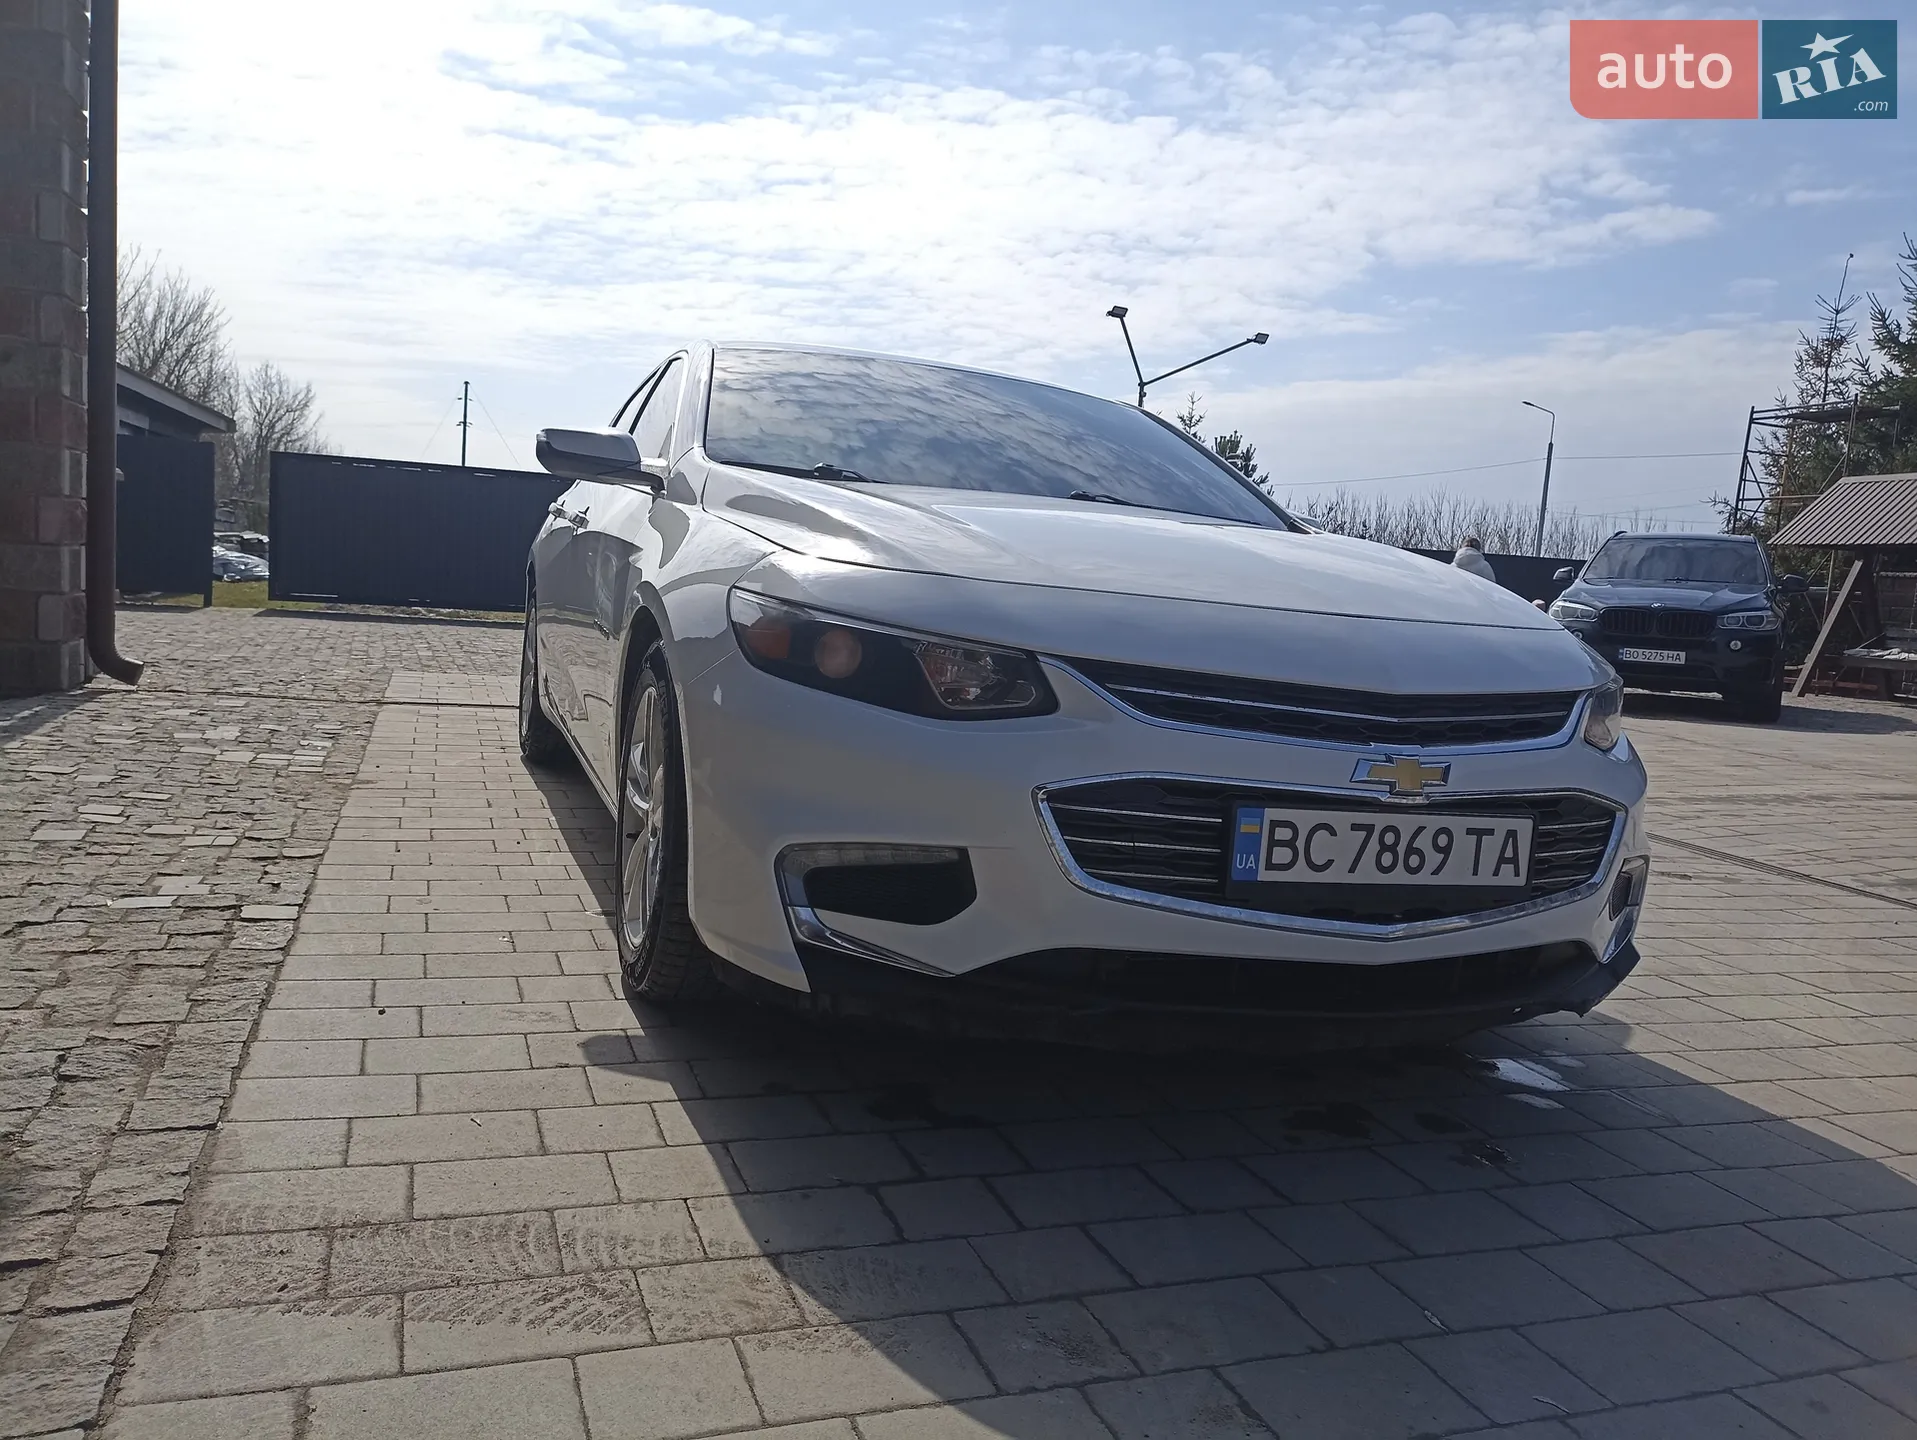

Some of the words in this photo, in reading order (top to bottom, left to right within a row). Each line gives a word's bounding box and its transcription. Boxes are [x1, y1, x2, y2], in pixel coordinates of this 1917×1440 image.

[1624, 650, 1639, 660] BO
[1642, 651, 1664, 662] 5275
[1667, 653, 1682, 662] HA
[1264, 819, 1338, 874] BC
[1347, 823, 1455, 876] 7869
[1465, 827, 1521, 878] TA
[1236, 853, 1256, 870] UA
